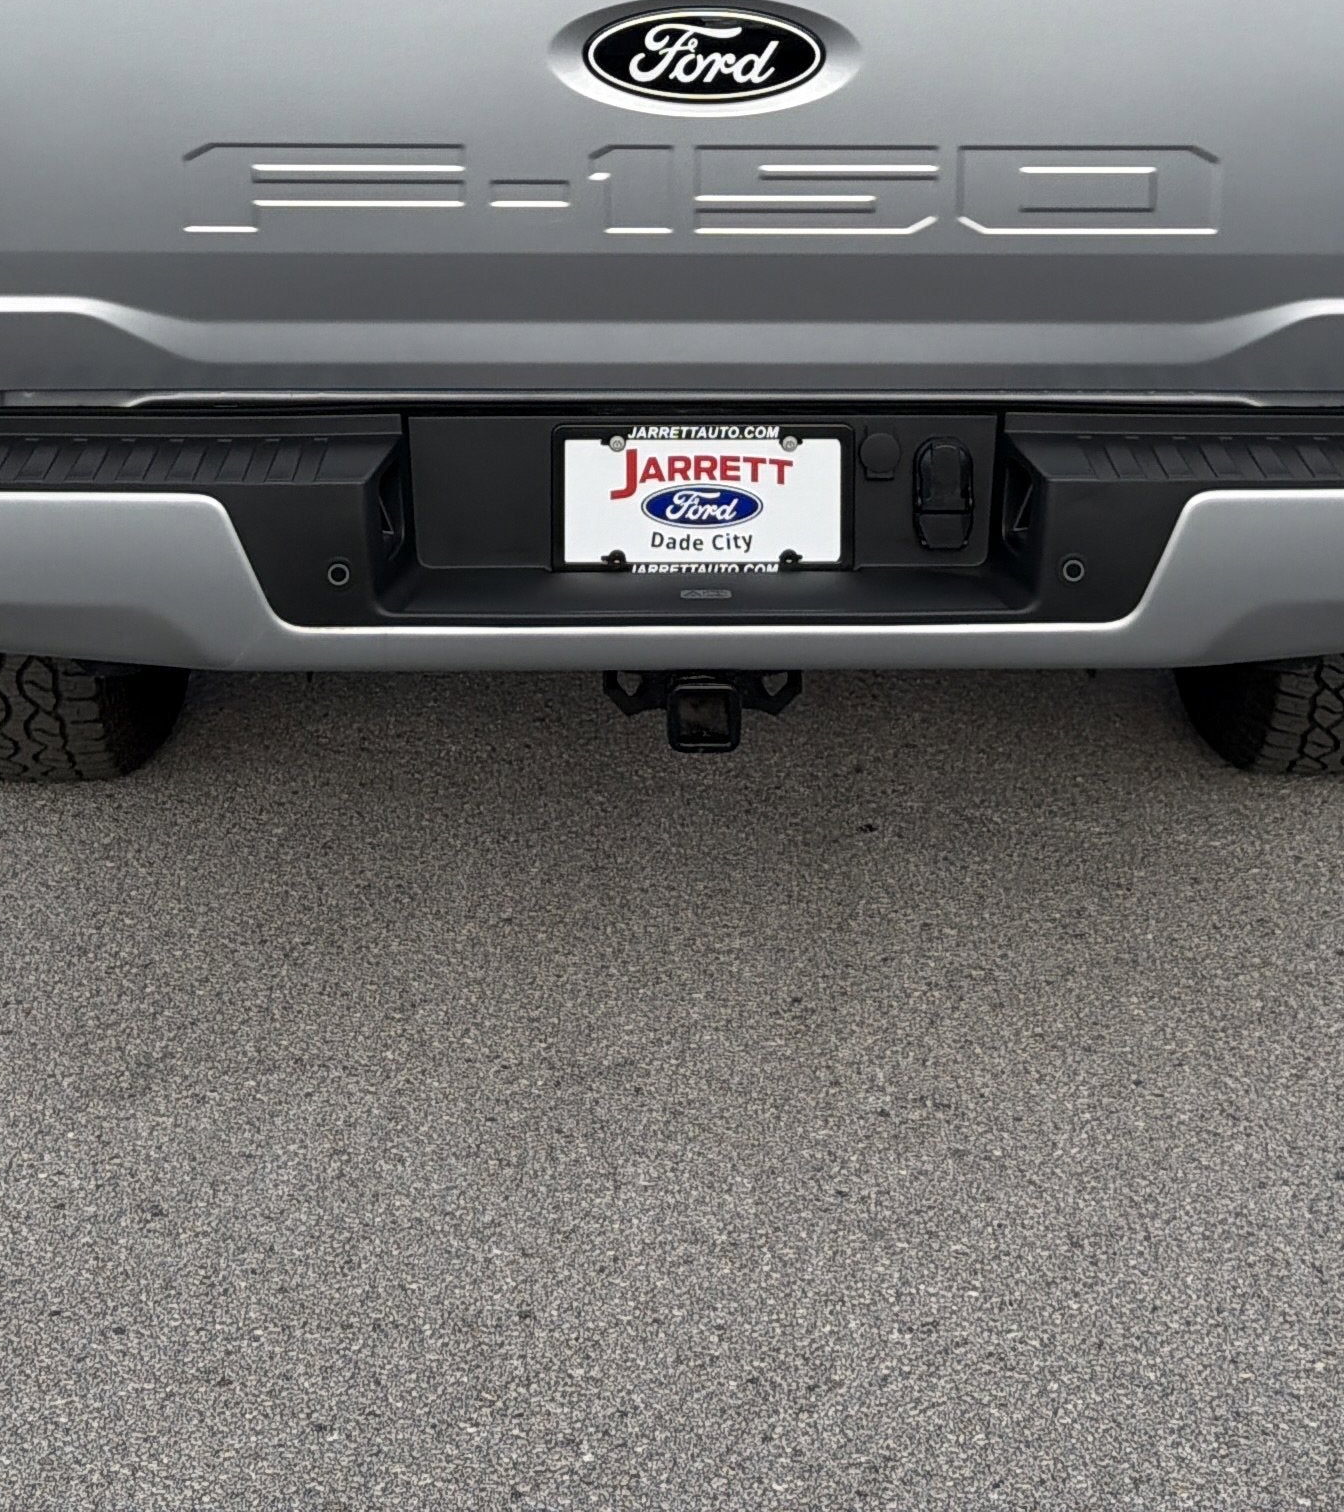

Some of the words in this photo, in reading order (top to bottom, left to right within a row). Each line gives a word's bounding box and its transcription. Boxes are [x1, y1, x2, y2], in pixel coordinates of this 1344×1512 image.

[628, 23, 780, 84] Ford
[182, 142, 1221, 235] F-150
[627, 426, 780, 438] JARRETTAUTO.COM
[610, 449, 794, 500] JARRETT
[666, 490, 739, 520] Ford
[651, 531, 704, 551] Dade
[712, 534, 753, 553] City
[631, 563, 780, 574] JARRETTAUTOCOM
